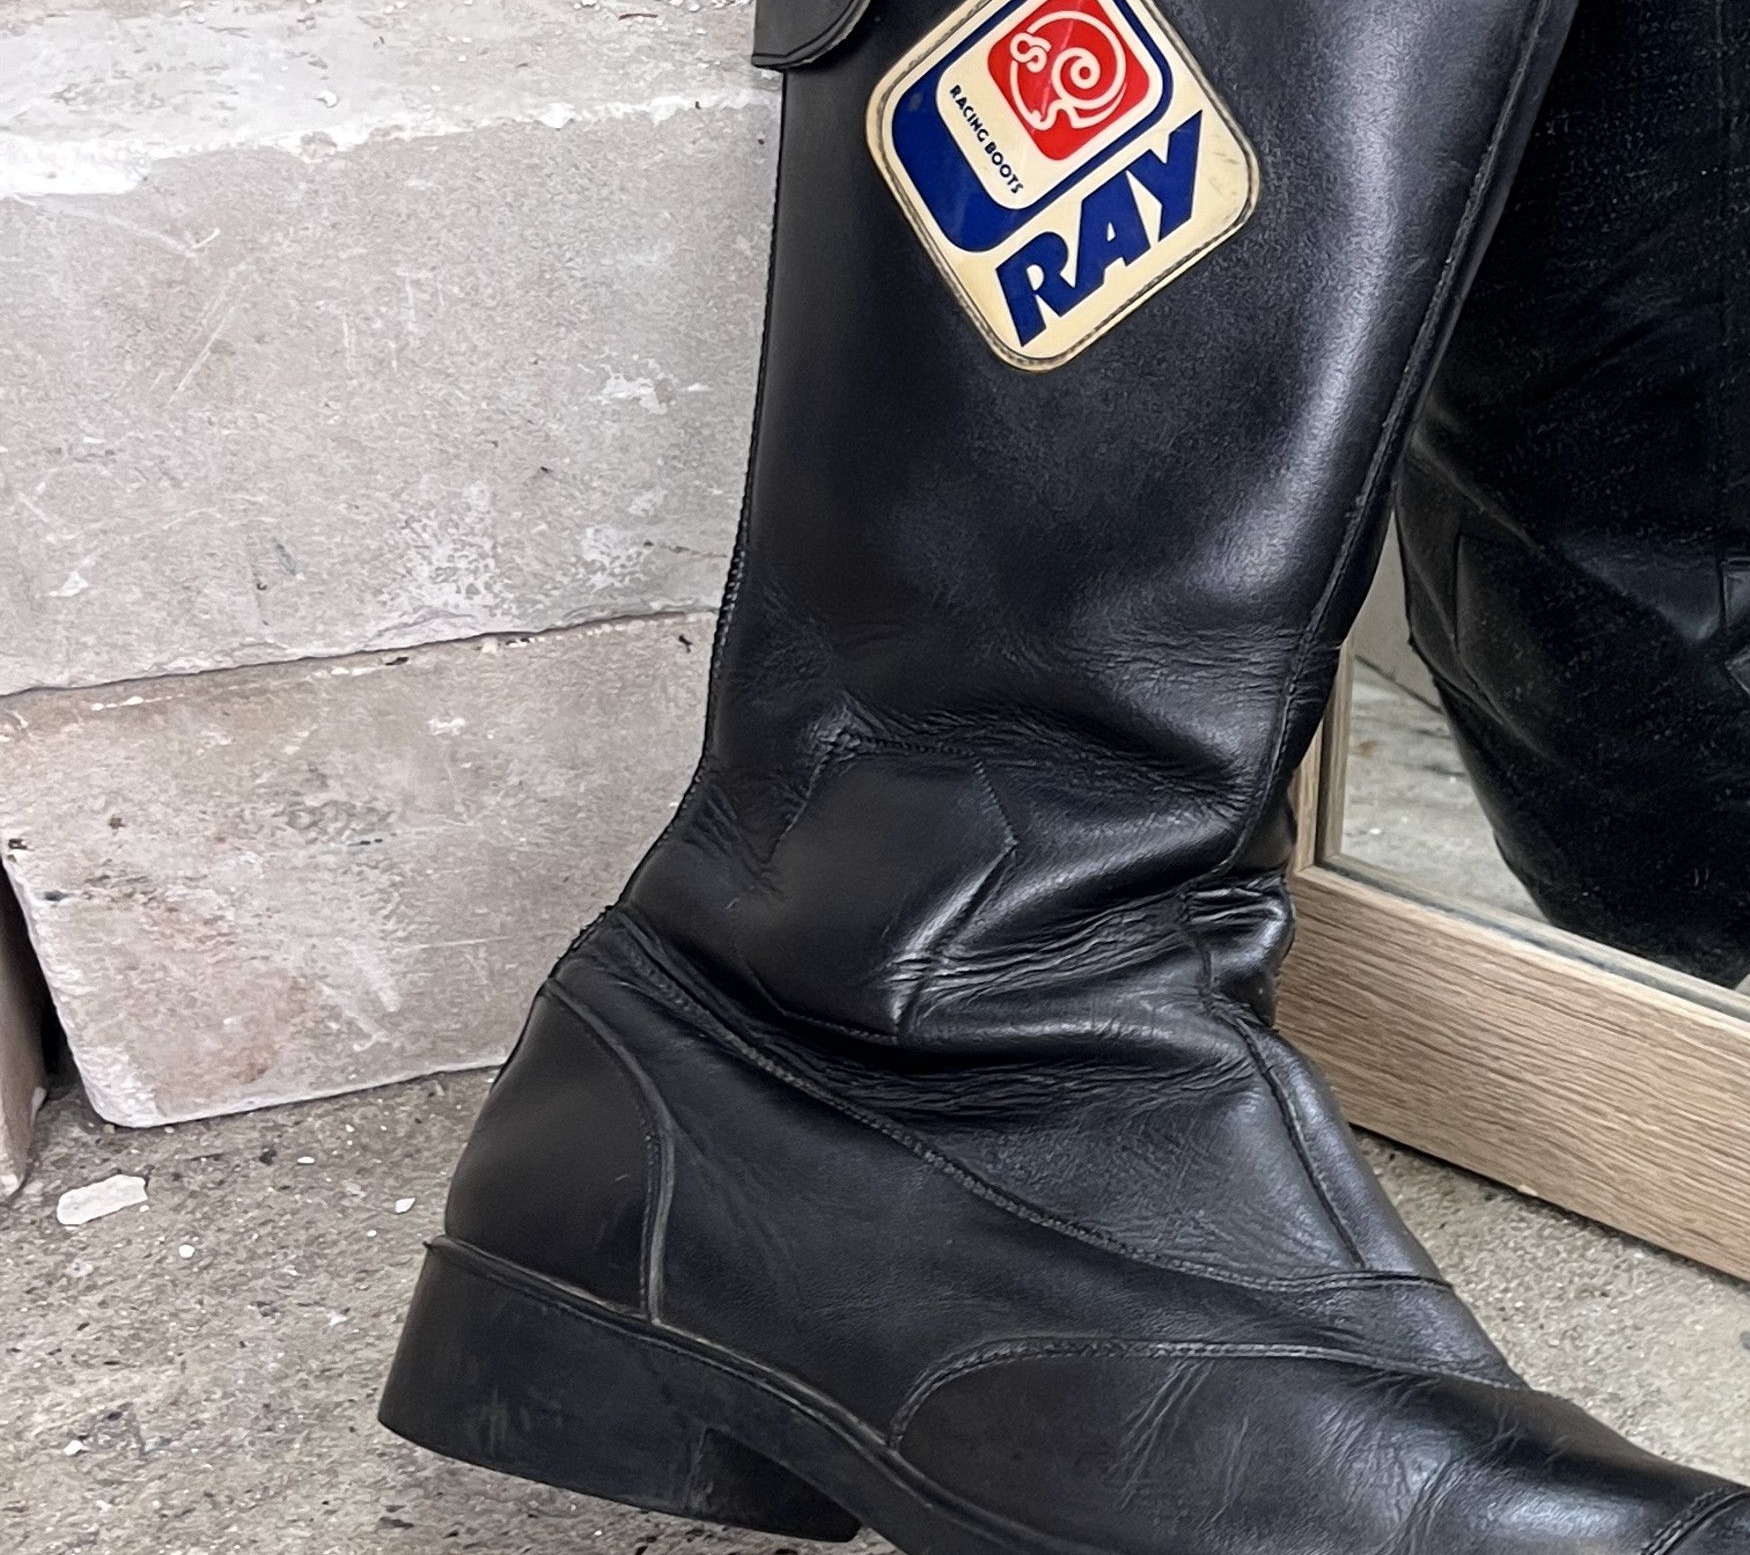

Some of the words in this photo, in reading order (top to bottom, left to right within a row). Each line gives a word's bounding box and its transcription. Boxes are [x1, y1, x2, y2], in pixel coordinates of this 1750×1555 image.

[949, 84, 989, 143] RACING
[984, 141, 1024, 194] BOOTS
[995, 109, 1203, 347] RAY
